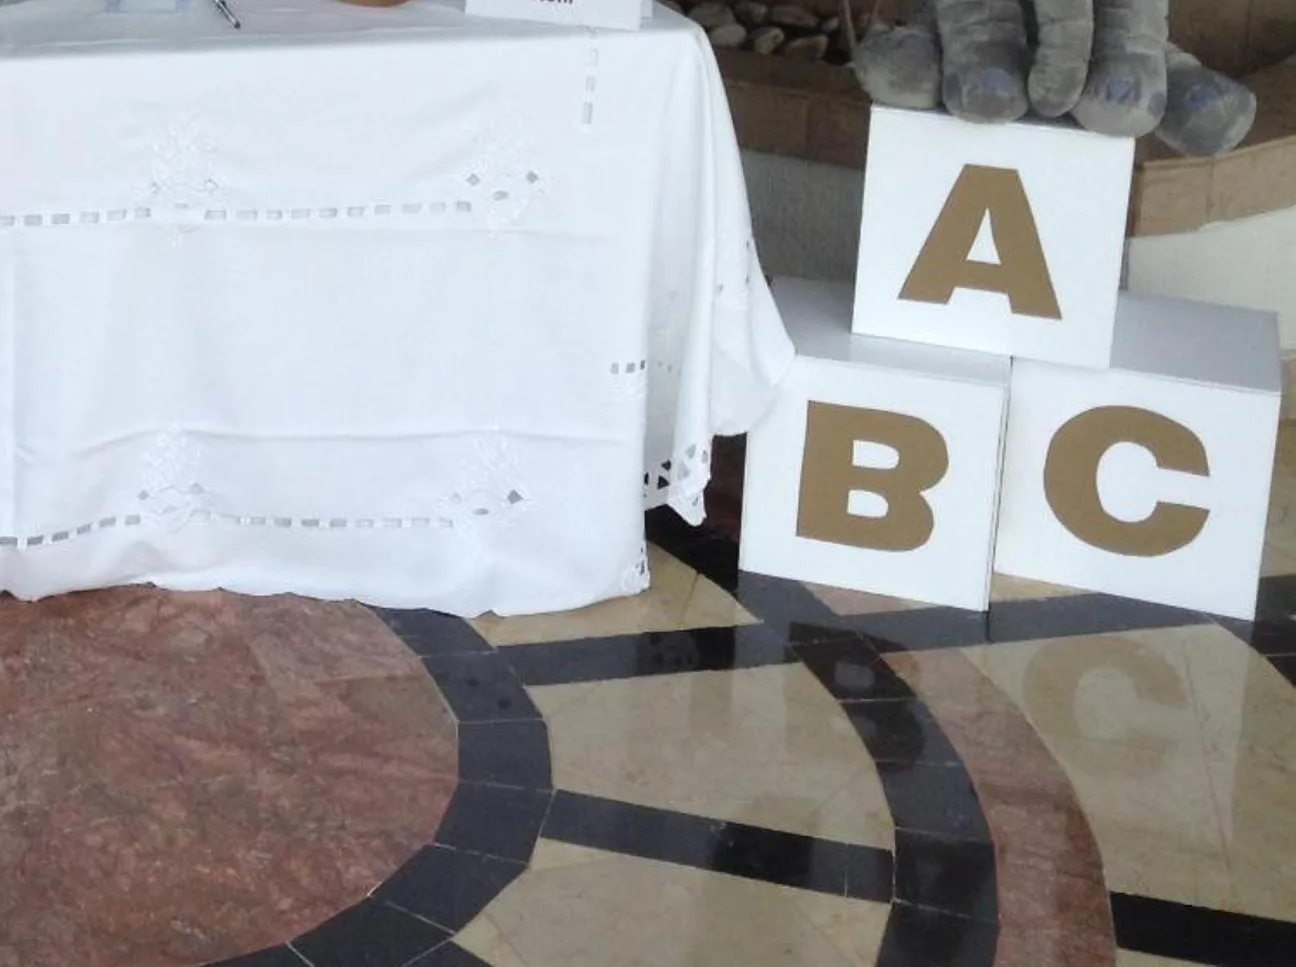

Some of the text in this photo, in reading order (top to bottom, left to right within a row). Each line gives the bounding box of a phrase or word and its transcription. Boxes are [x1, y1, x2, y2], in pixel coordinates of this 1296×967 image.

[897, 163, 1062, 320] A
[796, 399, 1210, 557] B C
